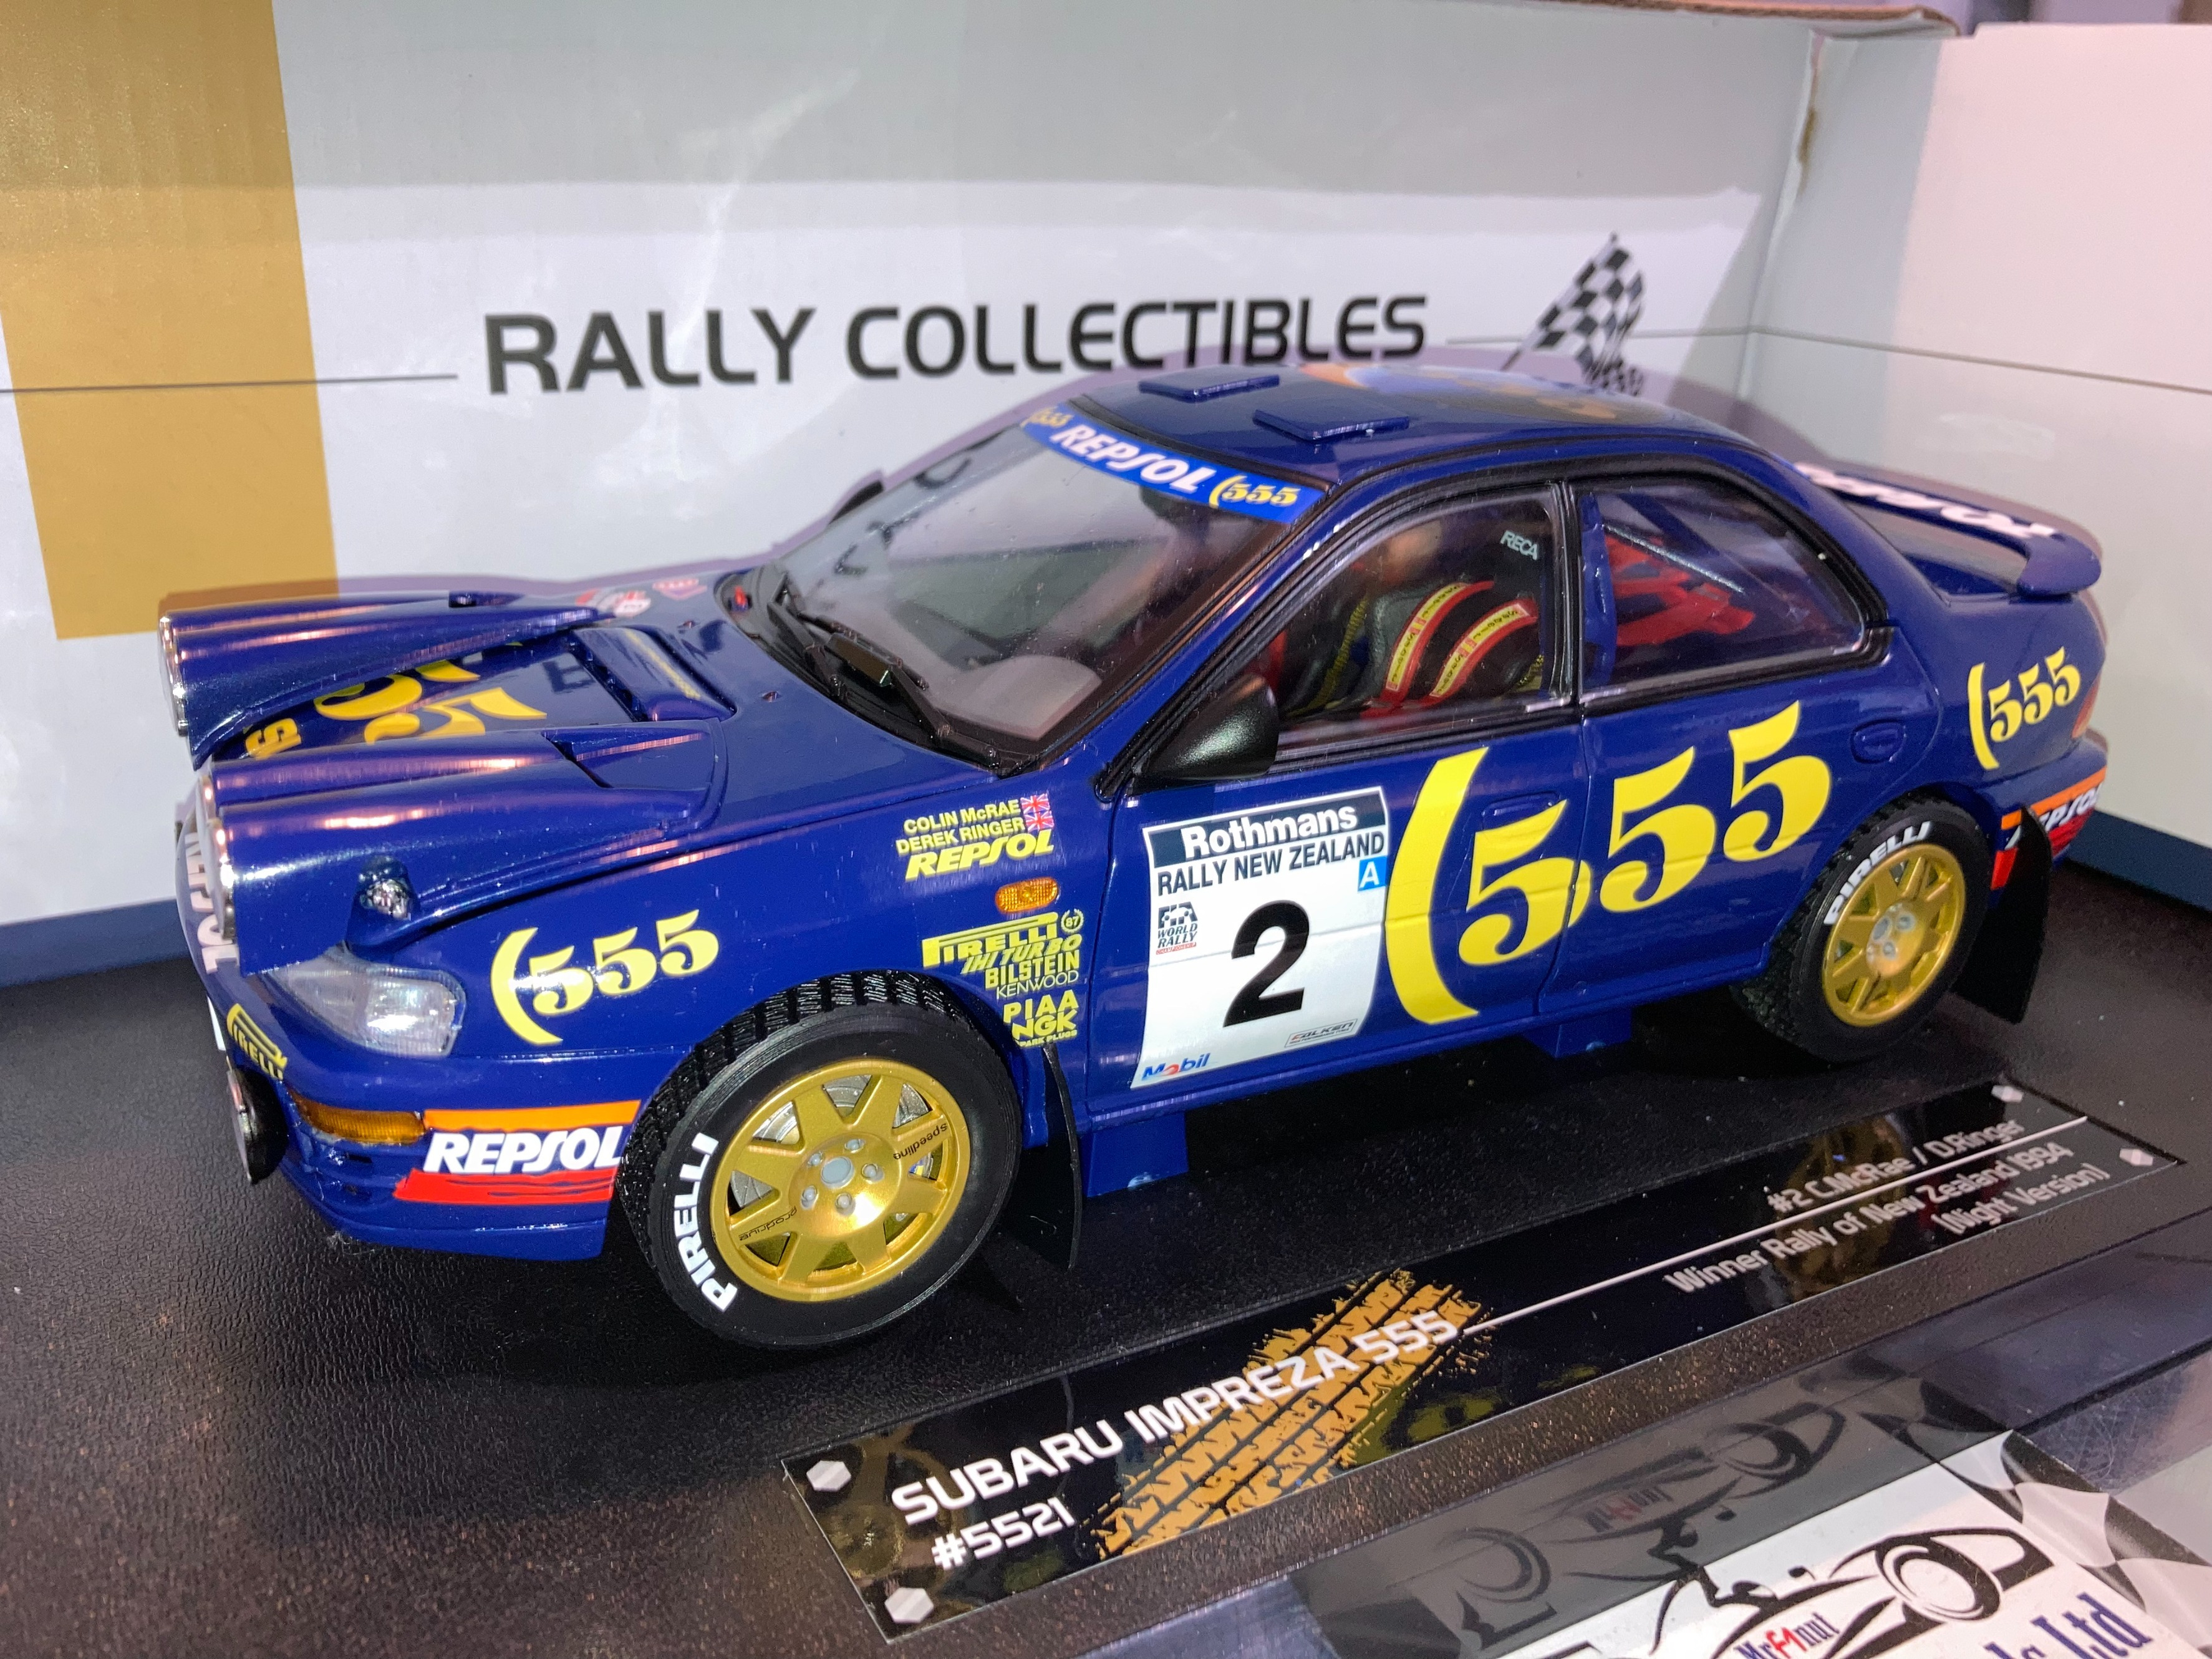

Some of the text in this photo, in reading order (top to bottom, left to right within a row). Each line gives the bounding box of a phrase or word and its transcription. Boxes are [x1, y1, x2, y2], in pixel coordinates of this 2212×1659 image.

[485, 296, 1428, 395] RALLY COLLECTIBLES
[1049, 424, 1217, 494] REPSOL
[896, 817, 1026, 856] DEREK RINGER
[904, 799, 1021, 834] COLIN McRAE
[1181, 805, 1357, 861] Rothmans
[905, 828, 1055, 881] REPSOL
[1157, 831, 1384, 896] RALLY NEW ZEALAND
[1359, 861, 1379, 891] A
[922, 912, 1058, 968] PIRELLI
[999, 934, 1082, 965] TURBO
[1157, 923, 1198, 939] WORLD
[1157, 931, 1197, 949] RALLY
[985, 950, 1079, 991] BILSTEIN
[1222, 899, 1310, 1028] 2
[997, 970, 1079, 1000] KENWOOD
[1003, 989, 1079, 1024] PIAA
[1012, 1008, 1078, 1041] NGK
[1142, 1053, 1210, 1081] Mobil
[423, 1125, 624, 1174] REPSOL
[893, 1123, 948, 1160] speedline
[1663, 1141, 2075, 1294] Winner Rally of New Zealand 1994
[1767, 1189, 1813, 1214] #2
[674, 1133, 738, 1312] PIRELLI
[891, 1310, 1458, 1524] SUBARU IMPREZA 555
[930, 1497, 1075, 1570] #5521
